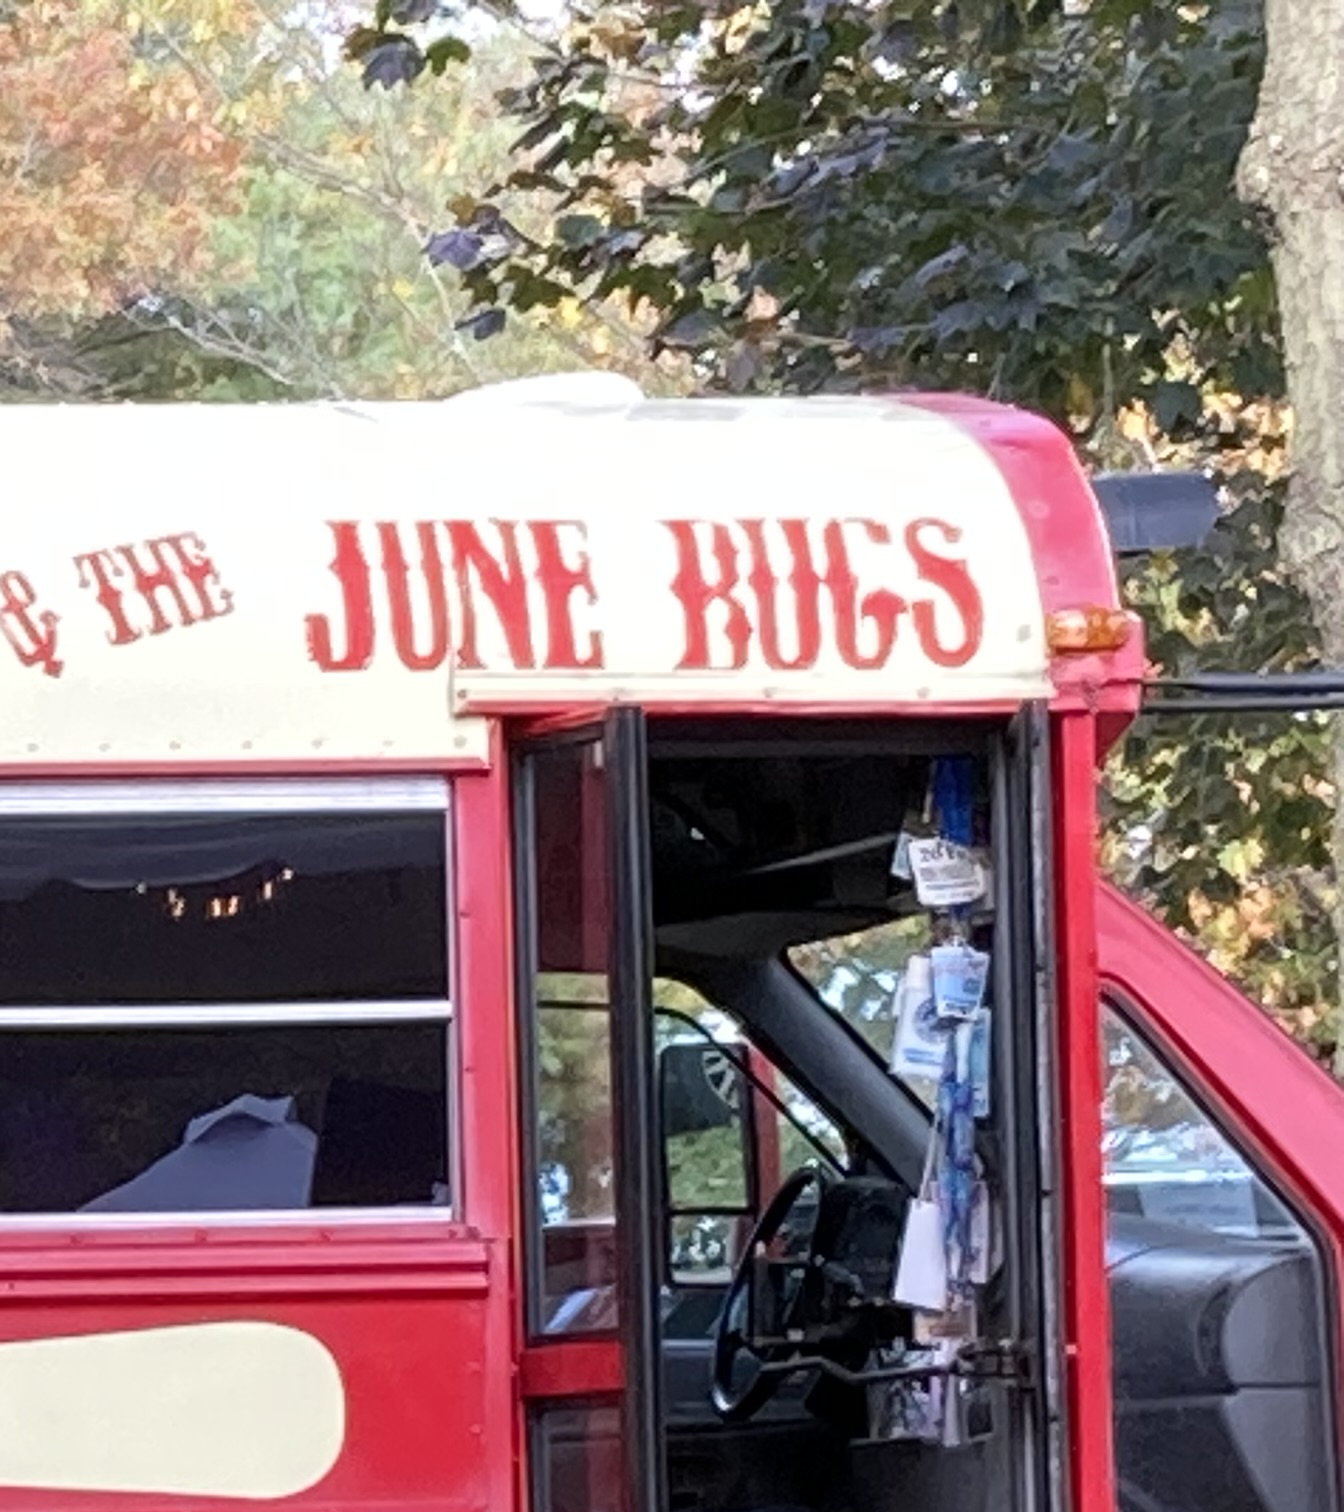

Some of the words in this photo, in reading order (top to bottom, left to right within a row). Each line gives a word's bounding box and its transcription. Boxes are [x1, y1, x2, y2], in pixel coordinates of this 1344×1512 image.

[74, 530, 235, 648] THE
[305, 518, 606, 673] JUNE
[657, 516, 983, 673] BUGS
